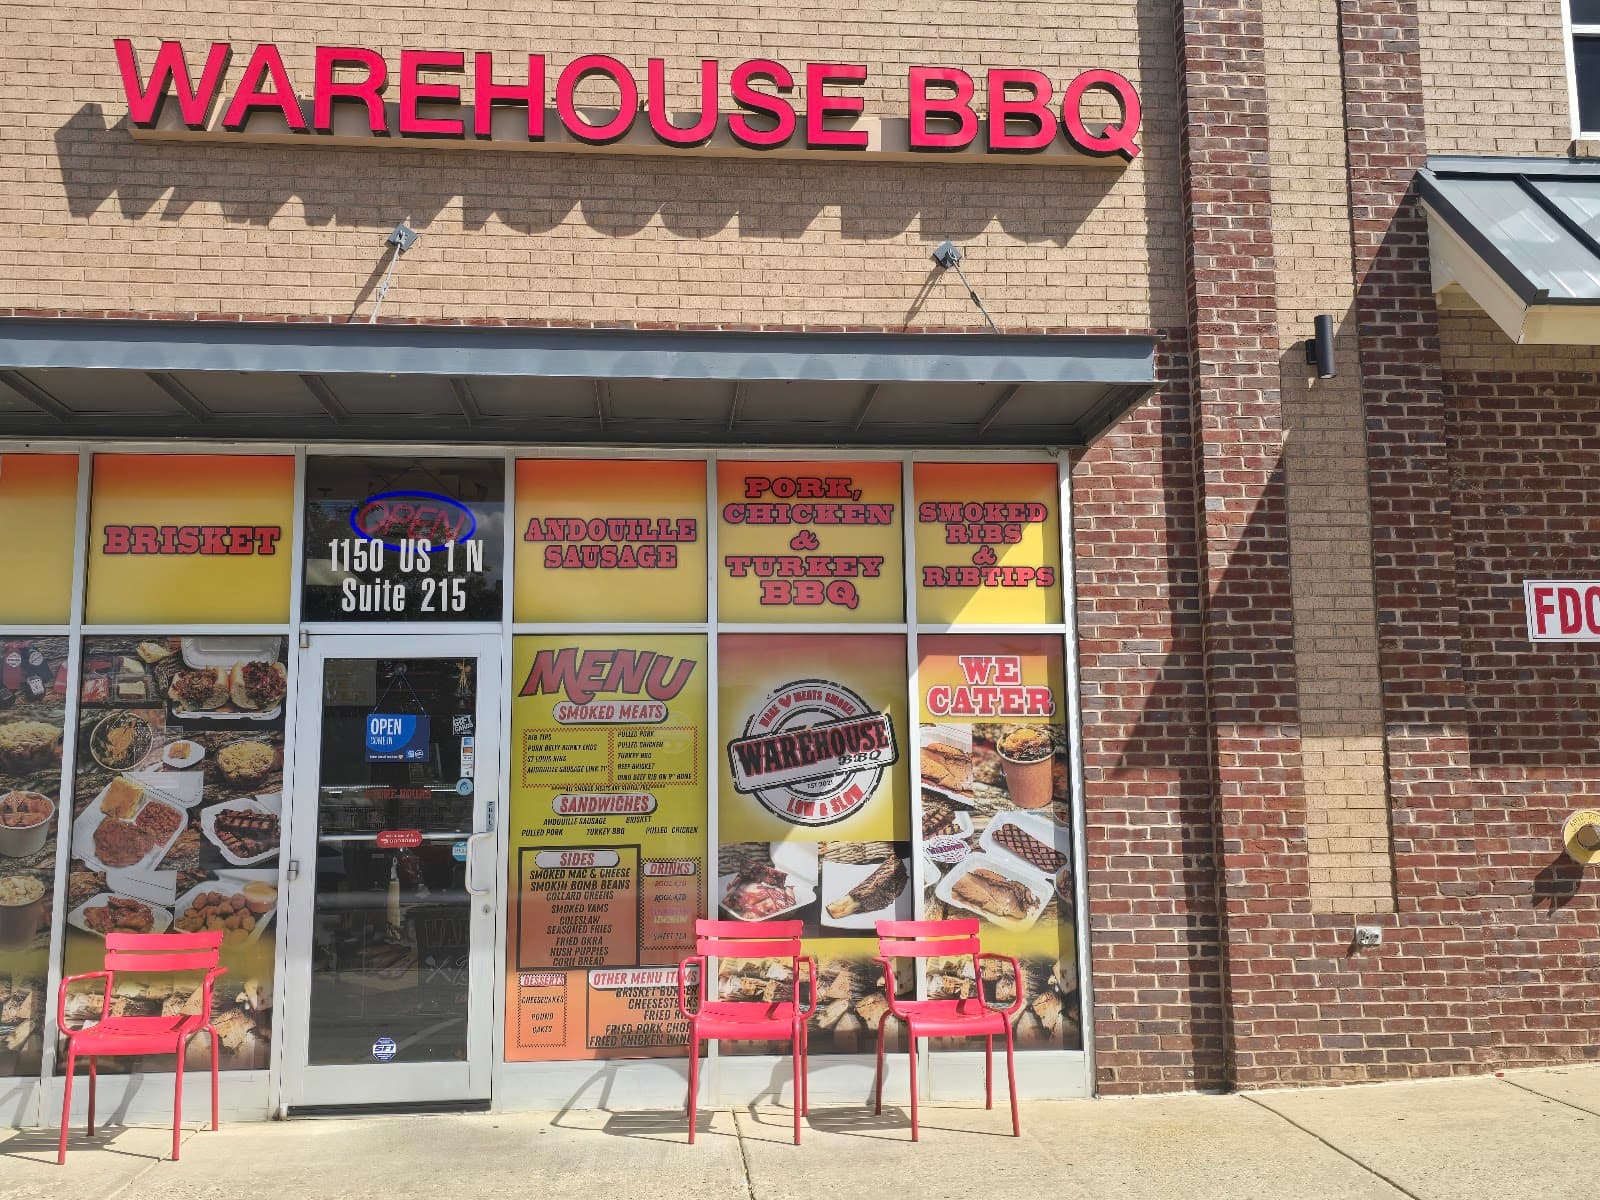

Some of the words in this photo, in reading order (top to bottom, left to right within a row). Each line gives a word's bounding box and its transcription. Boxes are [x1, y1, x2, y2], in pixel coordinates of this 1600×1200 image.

[113, 38, 868, 150] WAREHOUSE
[909, 65, 1141, 160] BBQ
[745, 477, 862, 501] PORK,
[723, 503, 894, 525] CHICKEN
[919, 502, 1048, 522] SMOKED
[358, 501, 466, 543] OPEN
[524, 518, 697, 542] ANDOUILLE
[103, 526, 281, 555] BRISKET
[790, 530, 819, 550] &
[946, 524, 1022, 544] RIBS
[328, 539, 383, 573] 1150
[400, 539, 431, 573] US
[444, 539, 456, 573] 1
[466, 540, 483, 573] N
[544, 545, 677, 568] SAUSAGE
[973, 546, 998, 565] &
[725, 556, 884, 577] TURKEY
[341, 577, 406, 612] Suite
[420, 578, 466, 612] 215
[760, 580, 859, 609] BBQ
[518, 647, 697, 706] MENU
[959, 655, 1021, 685] WE
[927, 686, 1056, 717] CATER
[558, 705, 615, 722] SMOKED
[618, 704, 664, 720] MEATS
[370, 718, 402, 735] OPEN
[734, 718, 889, 778] WAREHOUSE
[839, 749, 881, 765] BBQ
[559, 795, 649, 813] SANDWICHES
[787, 797, 816, 817] LOW
[830, 783, 864, 813] SLOW
[543, 817, 577, 826] ANDOUILLE
[579, 817, 606, 825] SAUSAGE
[625, 815, 652, 823] BRISKET
[521, 828, 545, 837] PULLED
[546, 828, 563, 836] PORK
[586, 827, 610, 836] TURKEY
[671, 826, 698, 834] CHICKEN
[560, 852, 596, 867] SIDES
[530, 869, 566, 880] SMOKED
[568, 869, 588, 879] MAC
[589, 868, 597, 879] &
[600, 867, 631, 878] CHEESE
[650, 862, 691, 875] DRINKS
[571, 880, 598, 890] BOMB
[600, 879, 631, 890] BEANS
[546, 891, 581, 902] COLLARD
[584, 890, 615, 900] GREENS
[551, 904, 584, 914] SMOKED
[587, 903, 609, 913] YAMS
[559, 915, 601, 926] COLESLAW
[546, 925, 588, 935] SEASONED
[590, 924, 613, 934] FRIES
[555, 937, 579, 946] FRIED
[581, 936, 603, 946] OKRA
[550, 947, 573, 957] HUSH
[574, 946, 609, 956] PUPPIES
[552, 957, 576, 966] CORN
[577, 956, 605, 966] BREAD
[523, 975, 565, 986] DESSERTS
[593, 972, 628, 985] OTHER
[630, 971, 663, 985] MENU
[665, 970, 697, 984] ITMS
[616, 986, 658, 998] BRISKET
[660, 984, 699, 997] BURER
[521, 995, 564, 1004] CHEESECAKES
[628, 997, 699, 1009] CHEESESTEKS
[532, 1013, 554, 1021] POUND
[643, 1009, 671, 1020] FRIED
[532, 1026, 553, 1034] CAKES
[605, 1024, 632, 1035] FRIED
[635, 1023, 664, 1034] PORK
[589, 1036, 617, 1047] FRIED
[620, 1034, 663, 1045] CHICKEN
